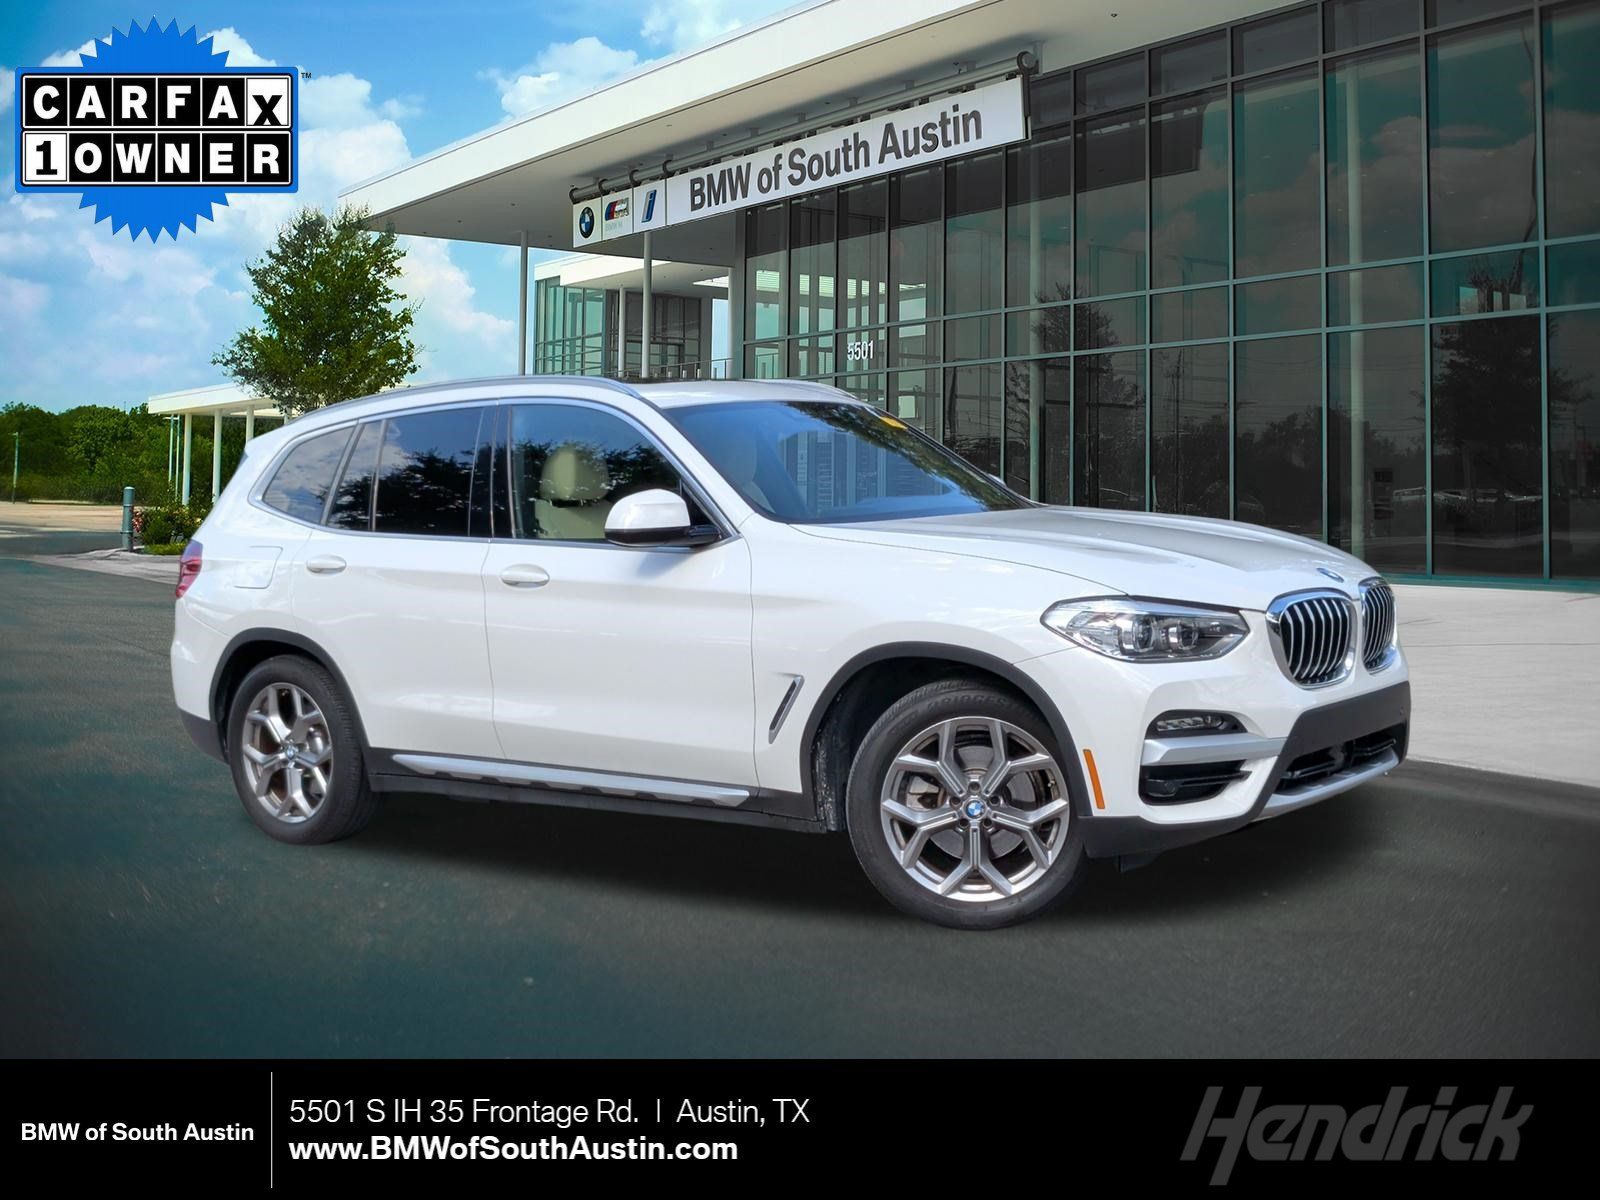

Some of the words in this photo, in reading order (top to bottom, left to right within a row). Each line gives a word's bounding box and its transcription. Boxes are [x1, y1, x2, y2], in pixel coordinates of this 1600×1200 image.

[689, 162, 752, 212] BMW
[756, 152, 783, 194] of
[786, 131, 871, 187] South
[877, 103, 983, 165] Austin
[847, 340, 874, 360] 5501
